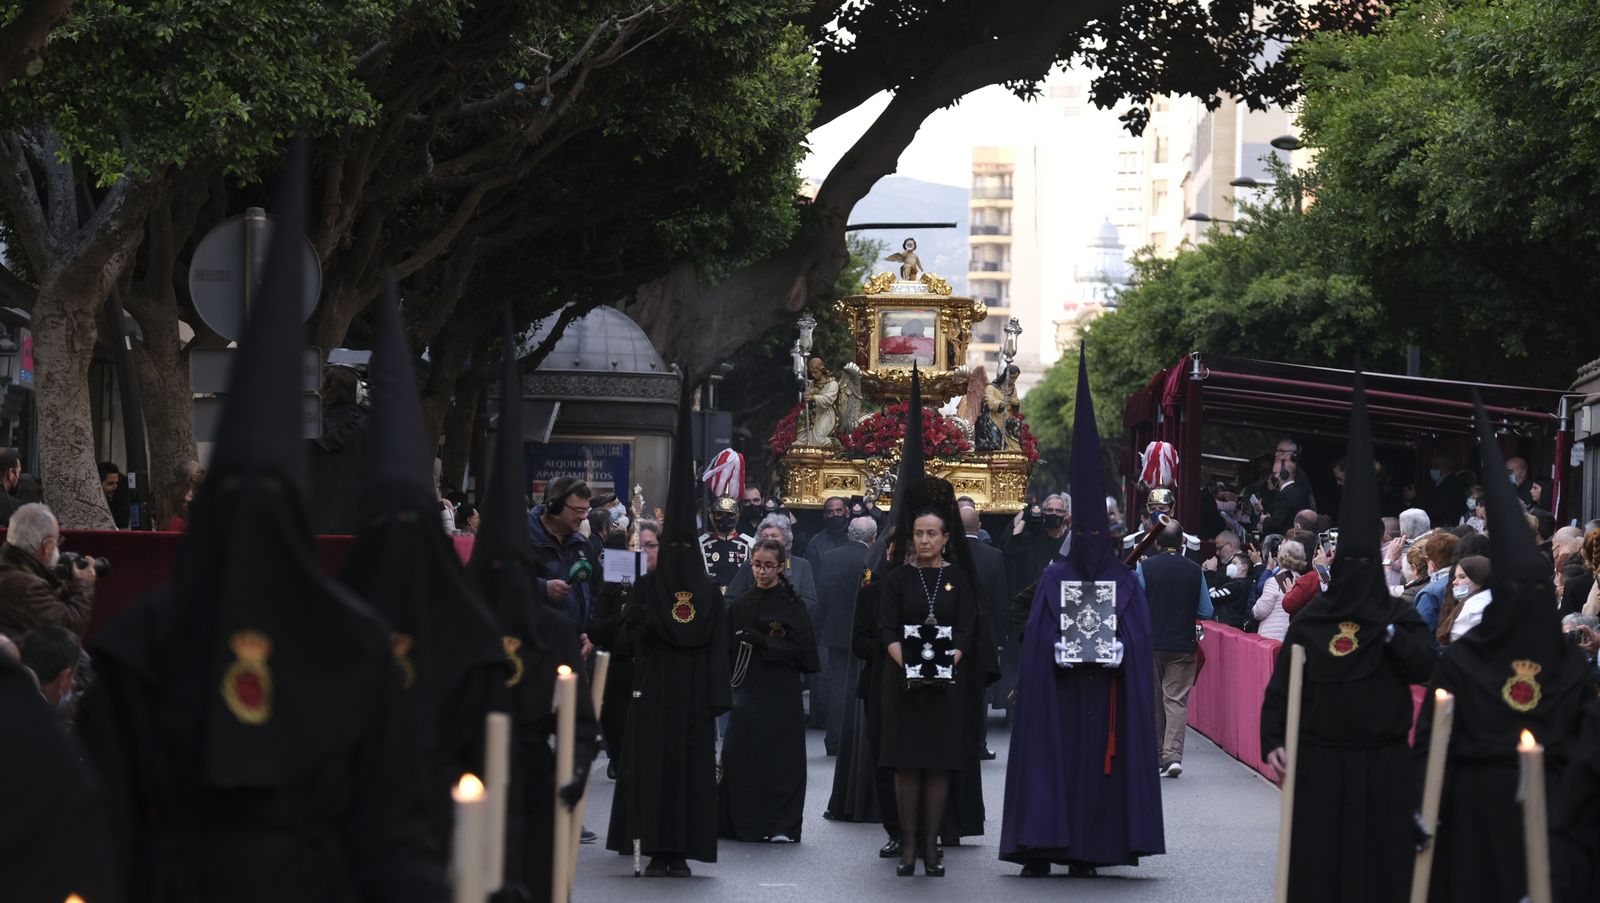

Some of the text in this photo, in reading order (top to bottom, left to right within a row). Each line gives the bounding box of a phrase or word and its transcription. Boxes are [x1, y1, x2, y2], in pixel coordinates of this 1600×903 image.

[544, 460, 605, 469] ALQUILER DE
[536, 471, 613, 480] APARTAMENTOS
